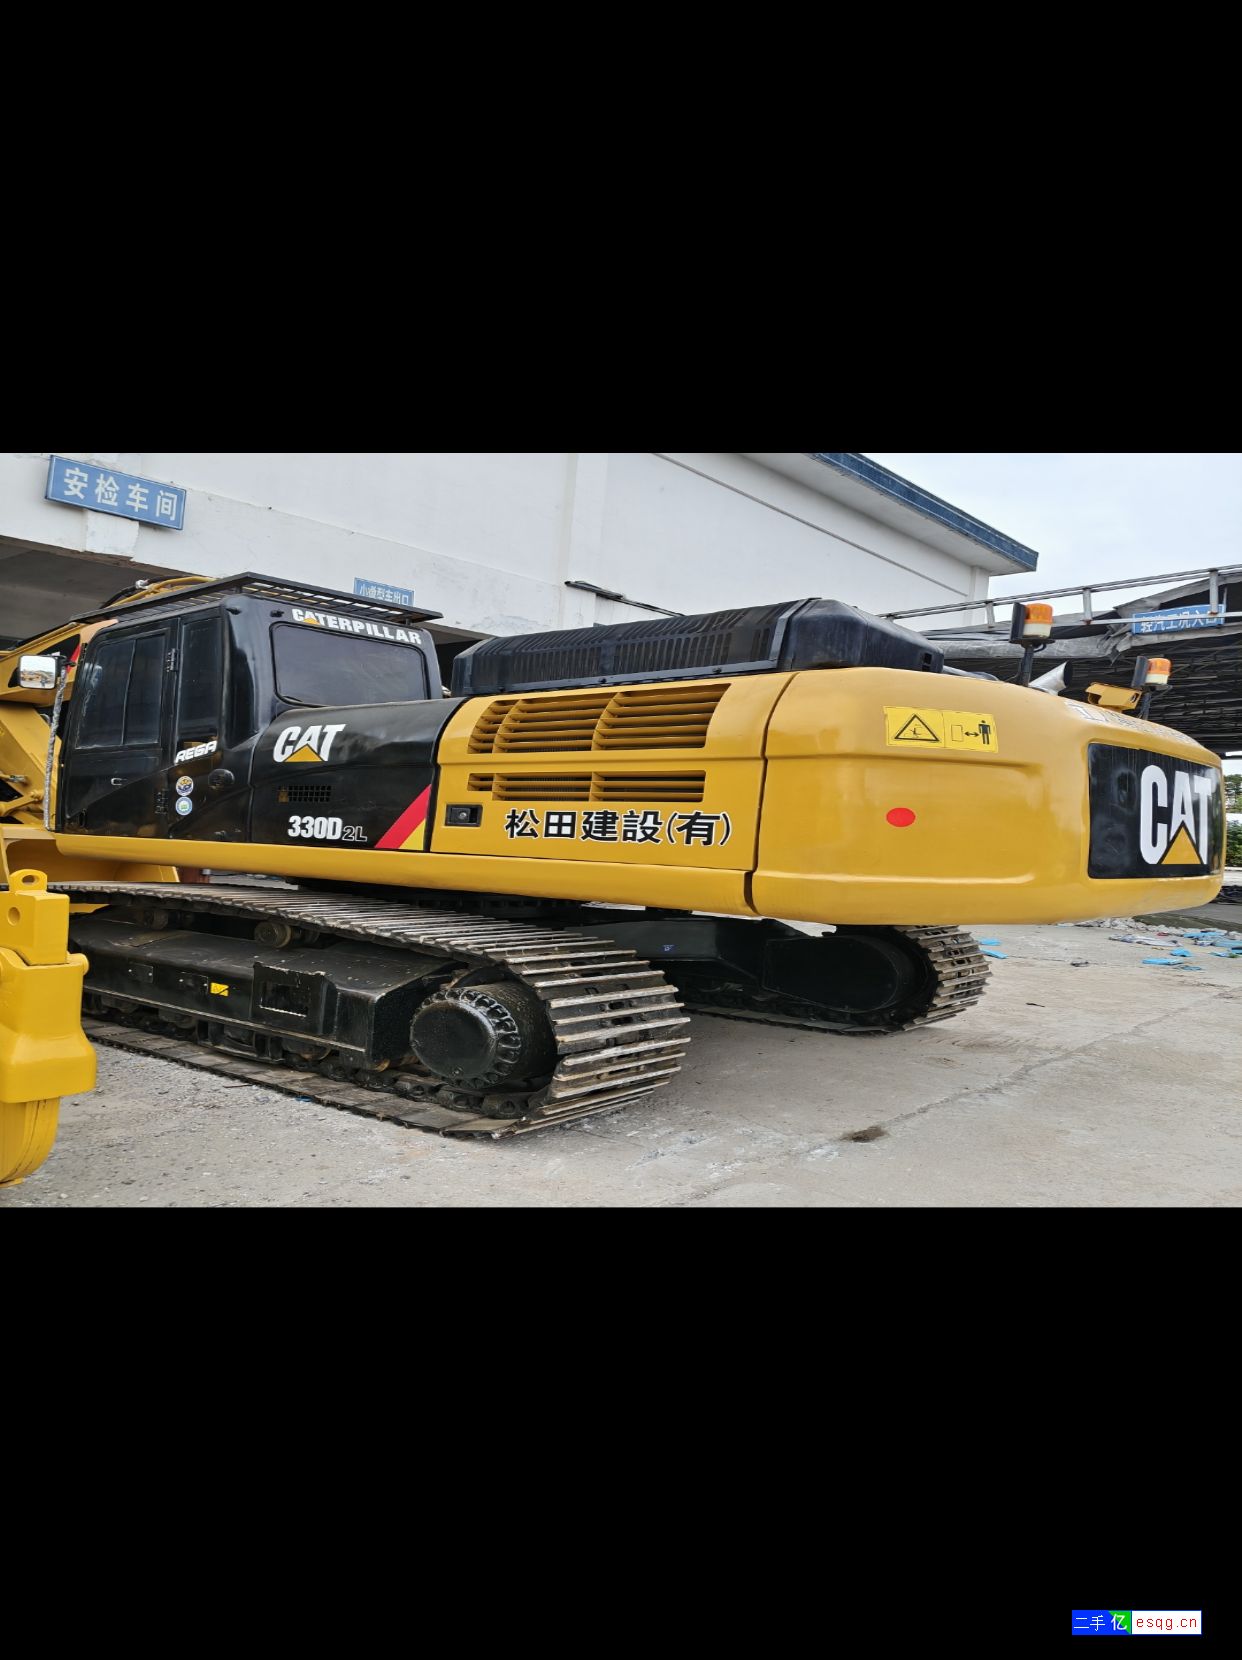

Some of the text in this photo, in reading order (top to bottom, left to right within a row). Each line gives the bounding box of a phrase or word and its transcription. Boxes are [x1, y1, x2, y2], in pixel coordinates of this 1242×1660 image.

[63, 467, 178, 521] 安检车间
[291, 608, 422, 645] CATERPILLAR
[273, 723, 347, 763] CAT
[504, 808, 733, 846] 松田建設(有)
[1139, 764, 1213, 865] CAT
